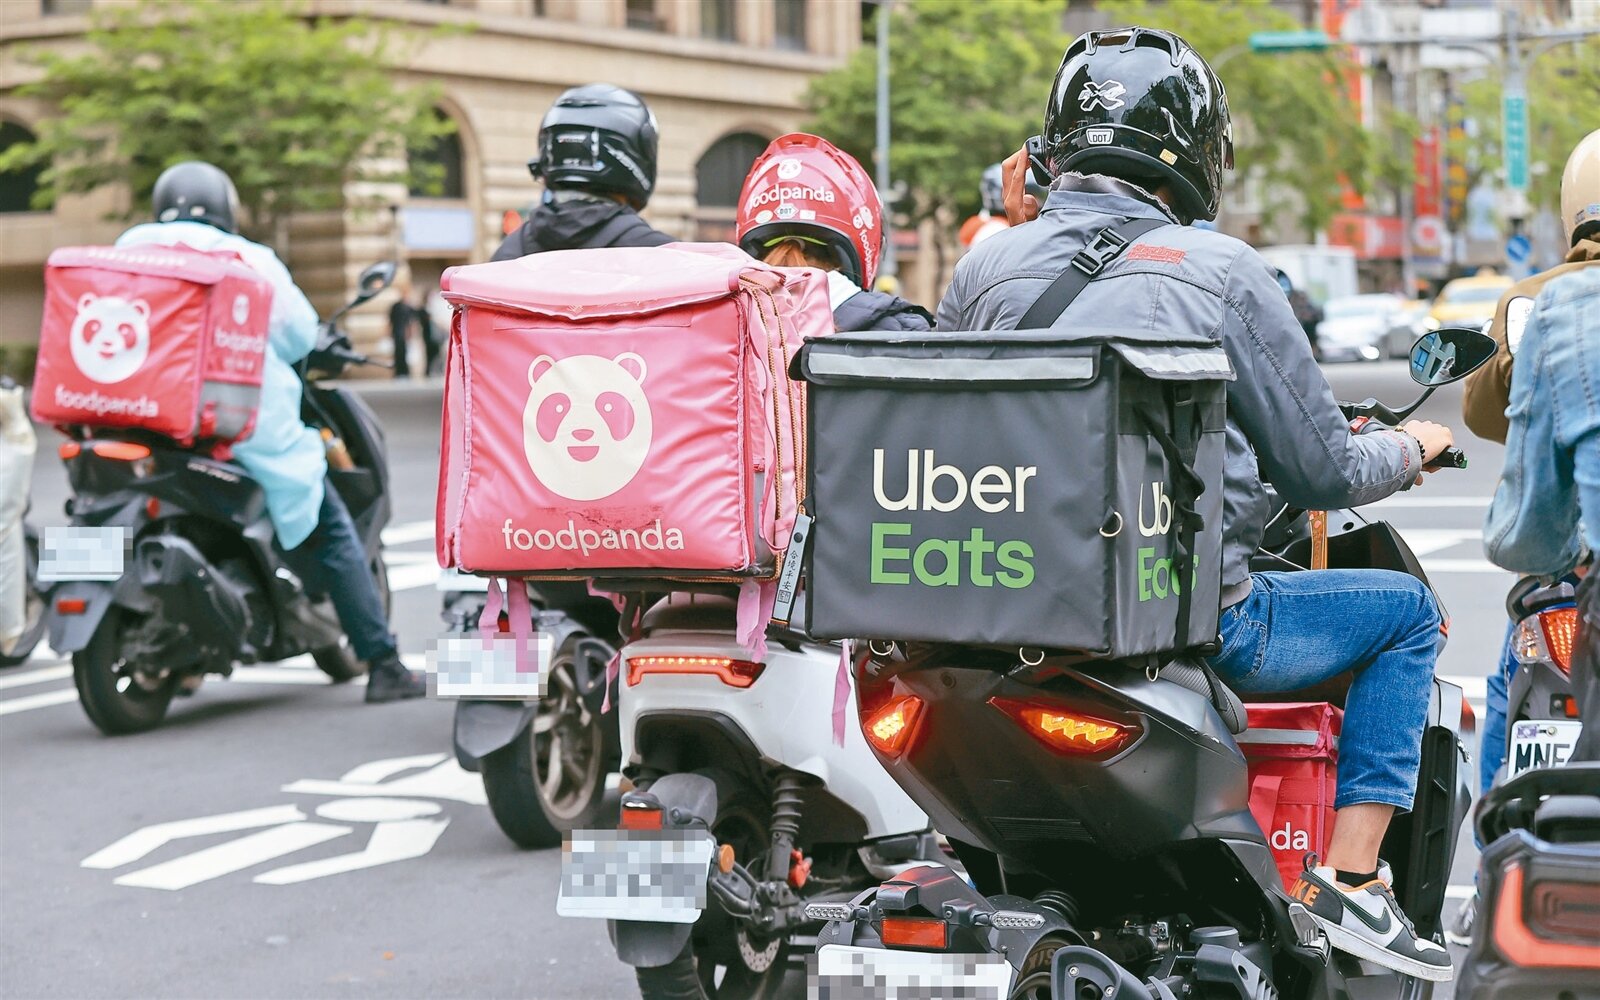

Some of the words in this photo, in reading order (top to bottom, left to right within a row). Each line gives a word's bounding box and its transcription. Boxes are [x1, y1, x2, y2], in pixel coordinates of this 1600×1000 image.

[1093, 135, 1107, 143] DOT
[55, 384, 159, 417] foodpanda
[873, 448, 1037, 513] Uber
[1138, 481, 1180, 537] Ub
[502, 518, 685, 557] foodpanda
[870, 522, 1035, 589] Eats
[1269, 822, 1309, 850] da
[1288, 877, 1321, 907] KE
